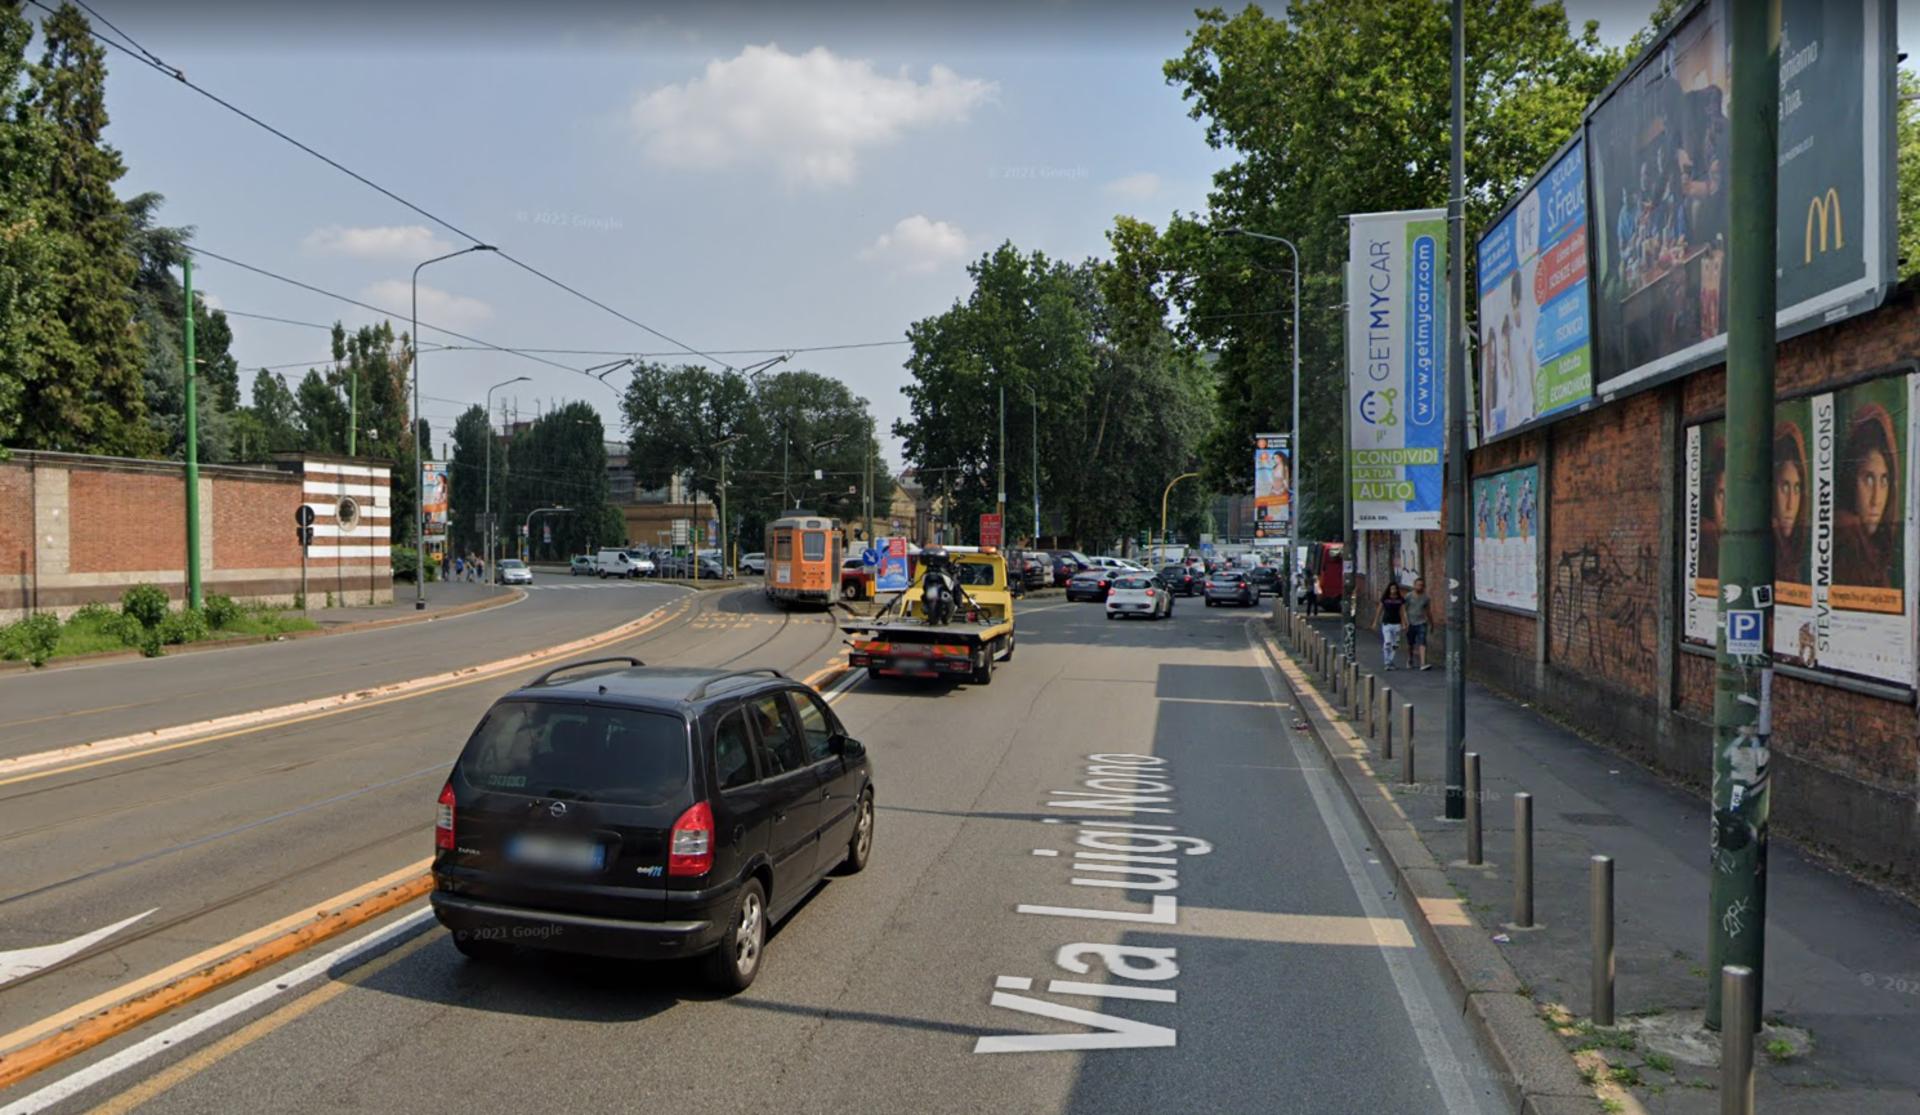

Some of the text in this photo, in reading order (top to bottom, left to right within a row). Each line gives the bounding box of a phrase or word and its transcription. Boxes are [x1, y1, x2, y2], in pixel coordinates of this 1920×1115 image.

[1417, 244, 1433, 416] www.getmycar.com
[1356, 449, 1438, 465] CONDIVIDI
[1358, 468, 1393, 478] LA TUA
[1690, 433, 1700, 487] ICONS
[1360, 482, 1412, 498] AUTO
[1688, 494, 1699, 578] McCURRY
[1817, 403, 1831, 653] STEVE McCURRY ICONS
[1735, 615, 1756, 640] P
